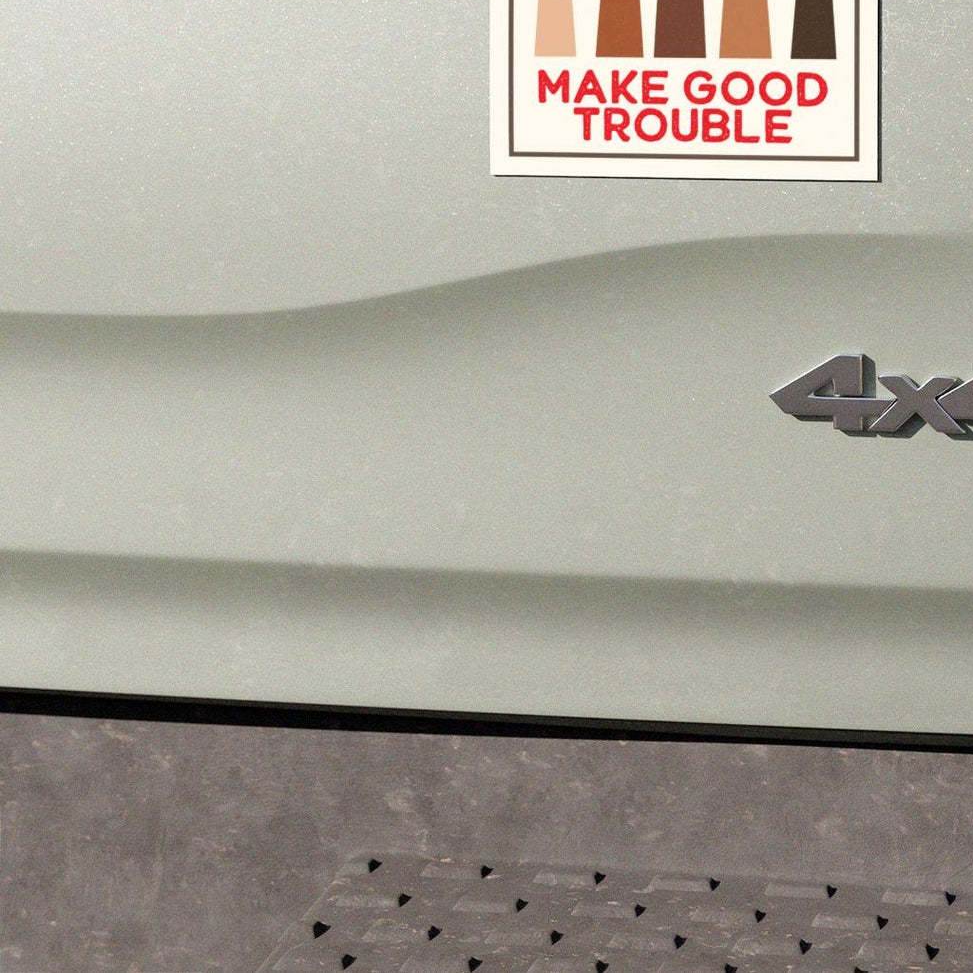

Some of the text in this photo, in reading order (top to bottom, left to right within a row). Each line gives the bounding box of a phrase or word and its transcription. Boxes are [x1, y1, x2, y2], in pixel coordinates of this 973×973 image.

[537, 69, 829, 107] MAKE GOOD
[573, 107, 793, 144] TROUBLE
